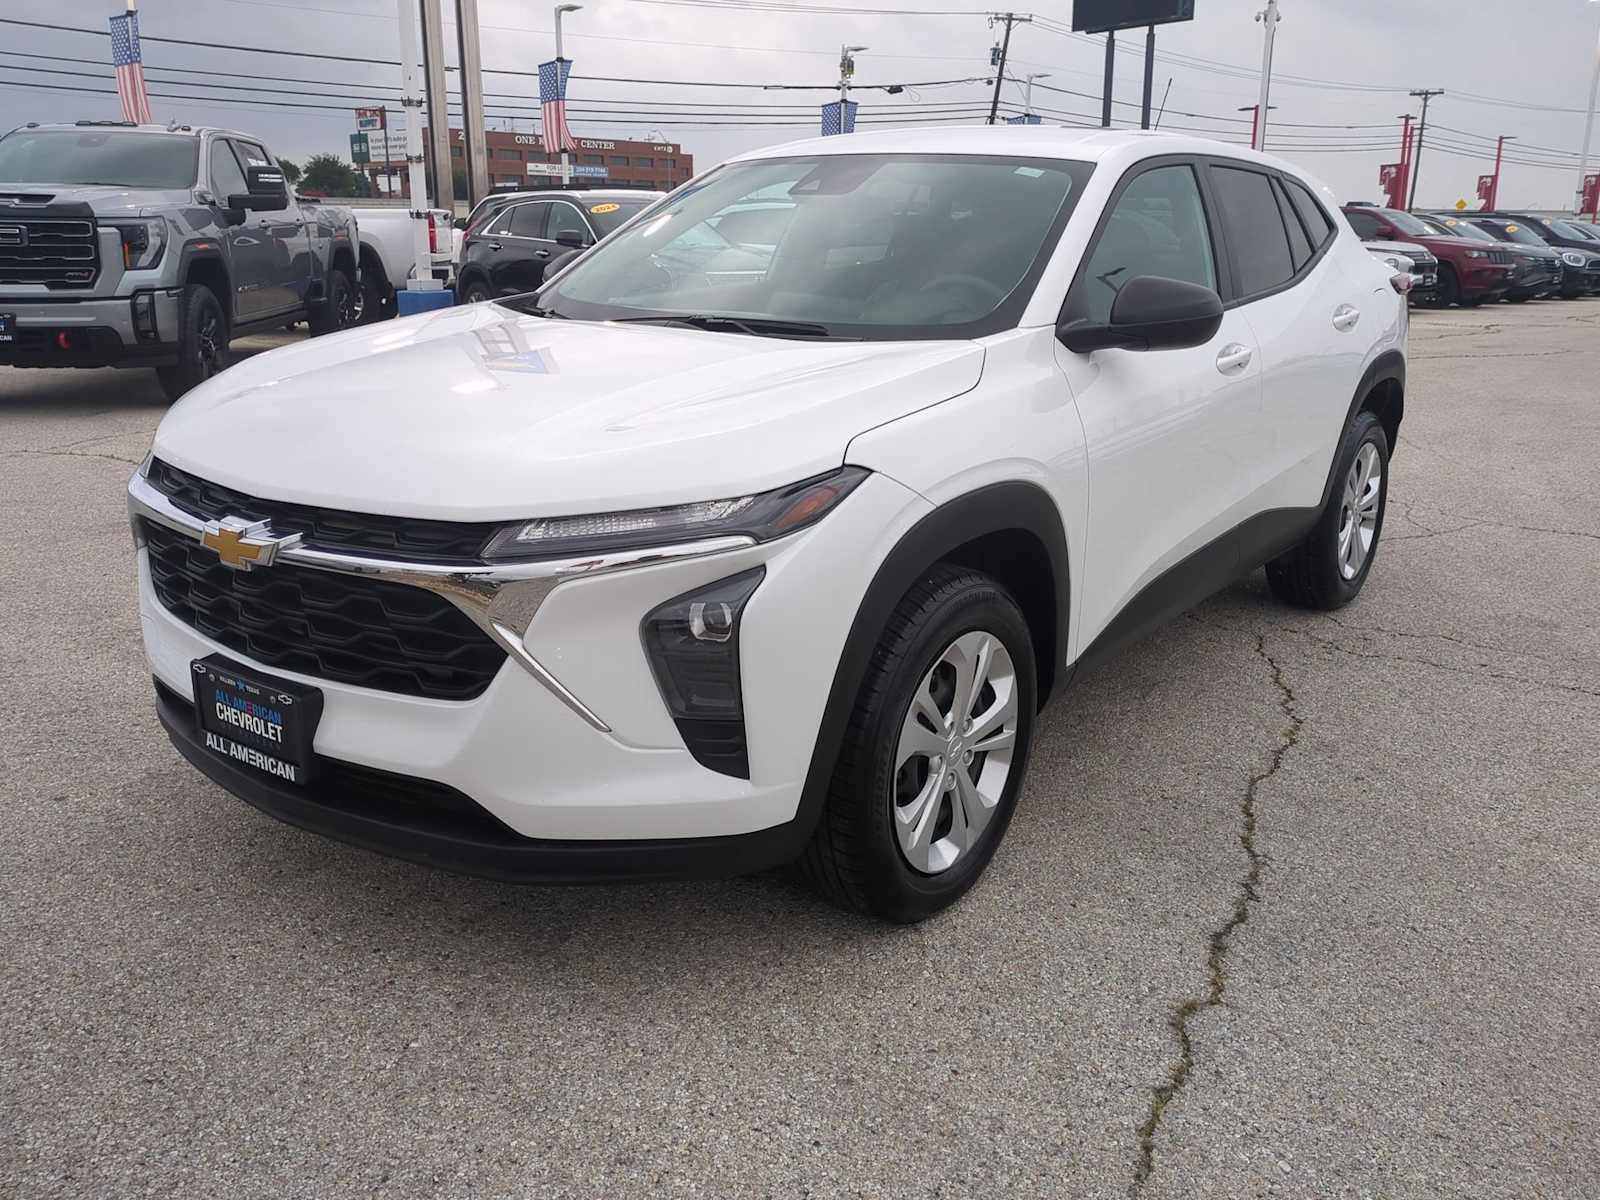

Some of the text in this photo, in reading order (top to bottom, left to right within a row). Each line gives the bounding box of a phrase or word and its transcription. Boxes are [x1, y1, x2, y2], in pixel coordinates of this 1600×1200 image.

[515, 135, 536, 145] ONE
[581, 139, 615, 150] CENTER
[215, 689, 282, 724] ALL AMERICAN
[215, 702, 283, 743] CHEVROLET
[206, 733, 295, 782] ALL AMERICAN
